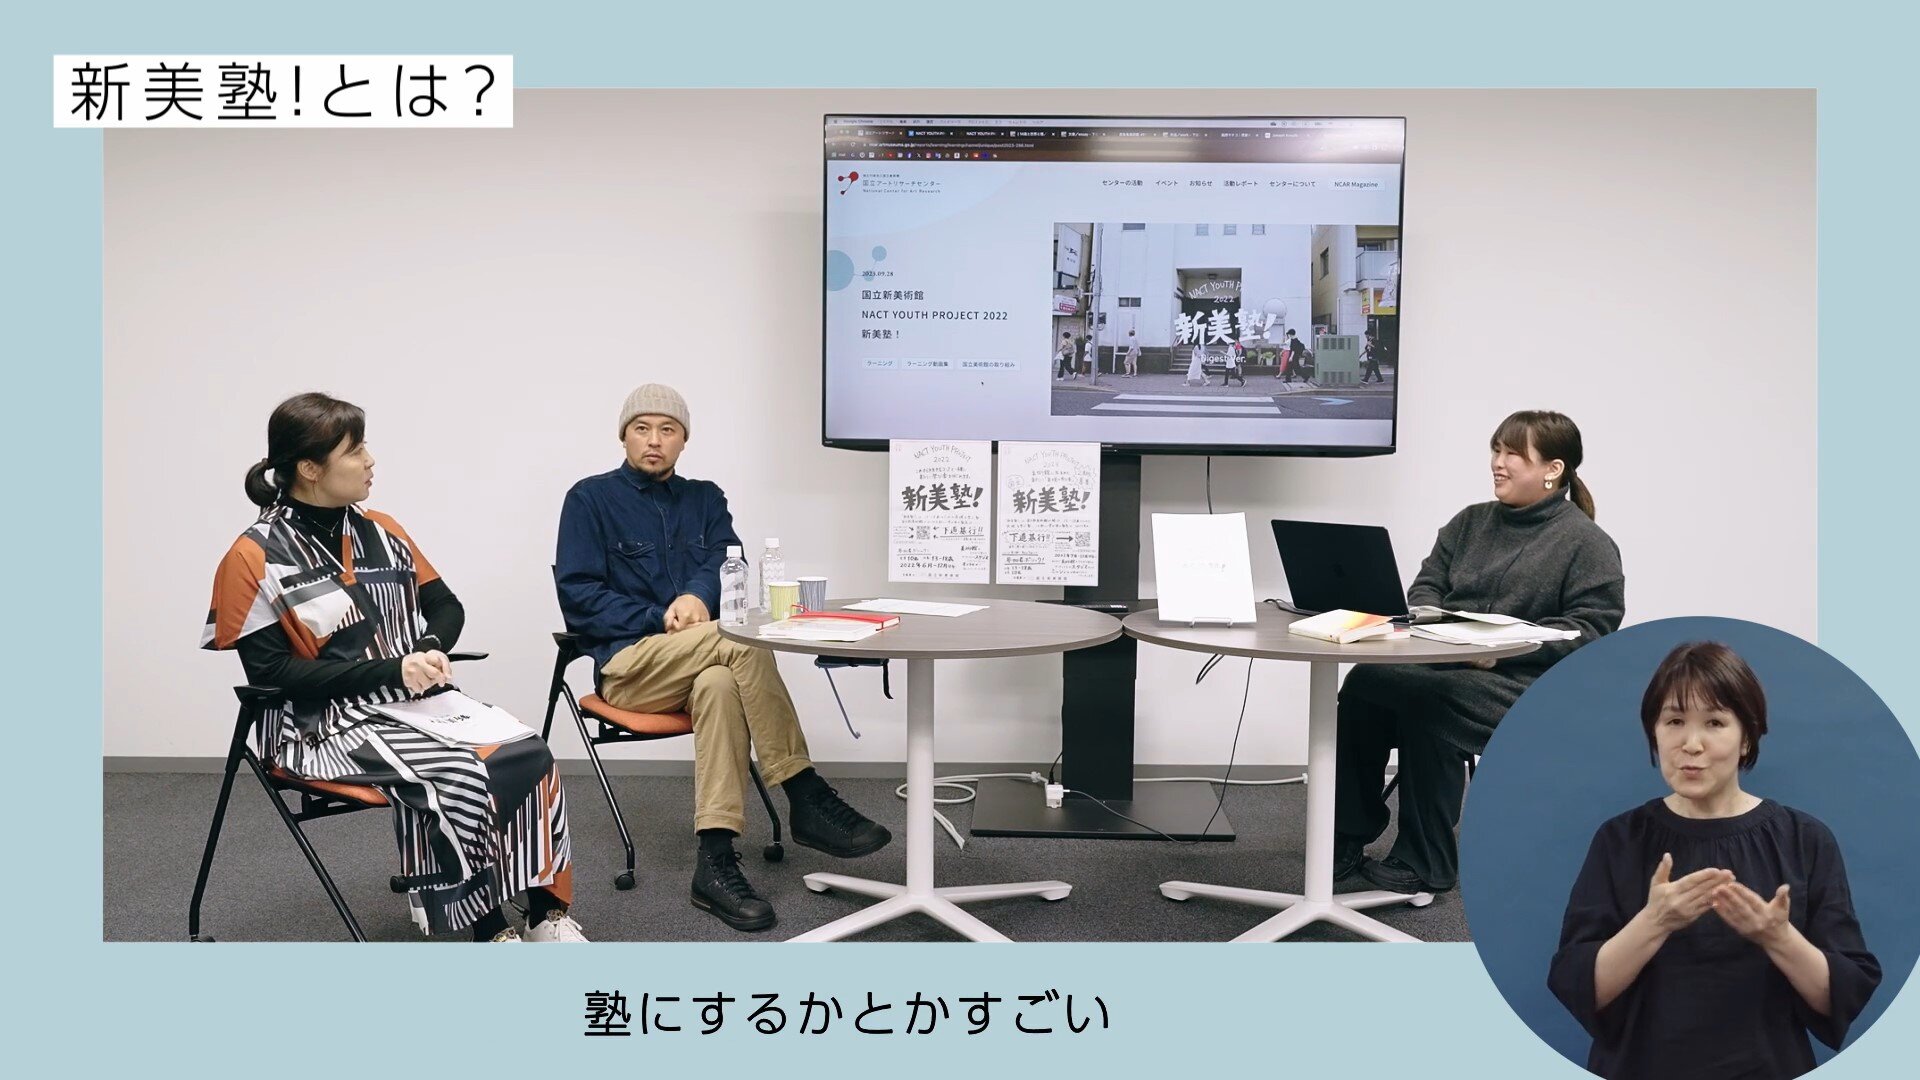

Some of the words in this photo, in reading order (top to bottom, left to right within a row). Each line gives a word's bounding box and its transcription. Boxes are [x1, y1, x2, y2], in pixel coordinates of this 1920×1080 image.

[862, 290, 924, 301] 国立新美術館
[1188, 283, 1209, 299] NACT
[1210, 280, 1235, 291] YOUTH
[862, 310, 889, 319] NACT
[892, 310, 928, 320] YOUTH
[932, 311, 979, 320] PROJECT
[983, 311, 1008, 320] 2022
[930, 445, 950, 453] YOUTH
[901, 483, 984, 512] 新美塾!
[1013, 486, 1090, 514] 新美塾!
